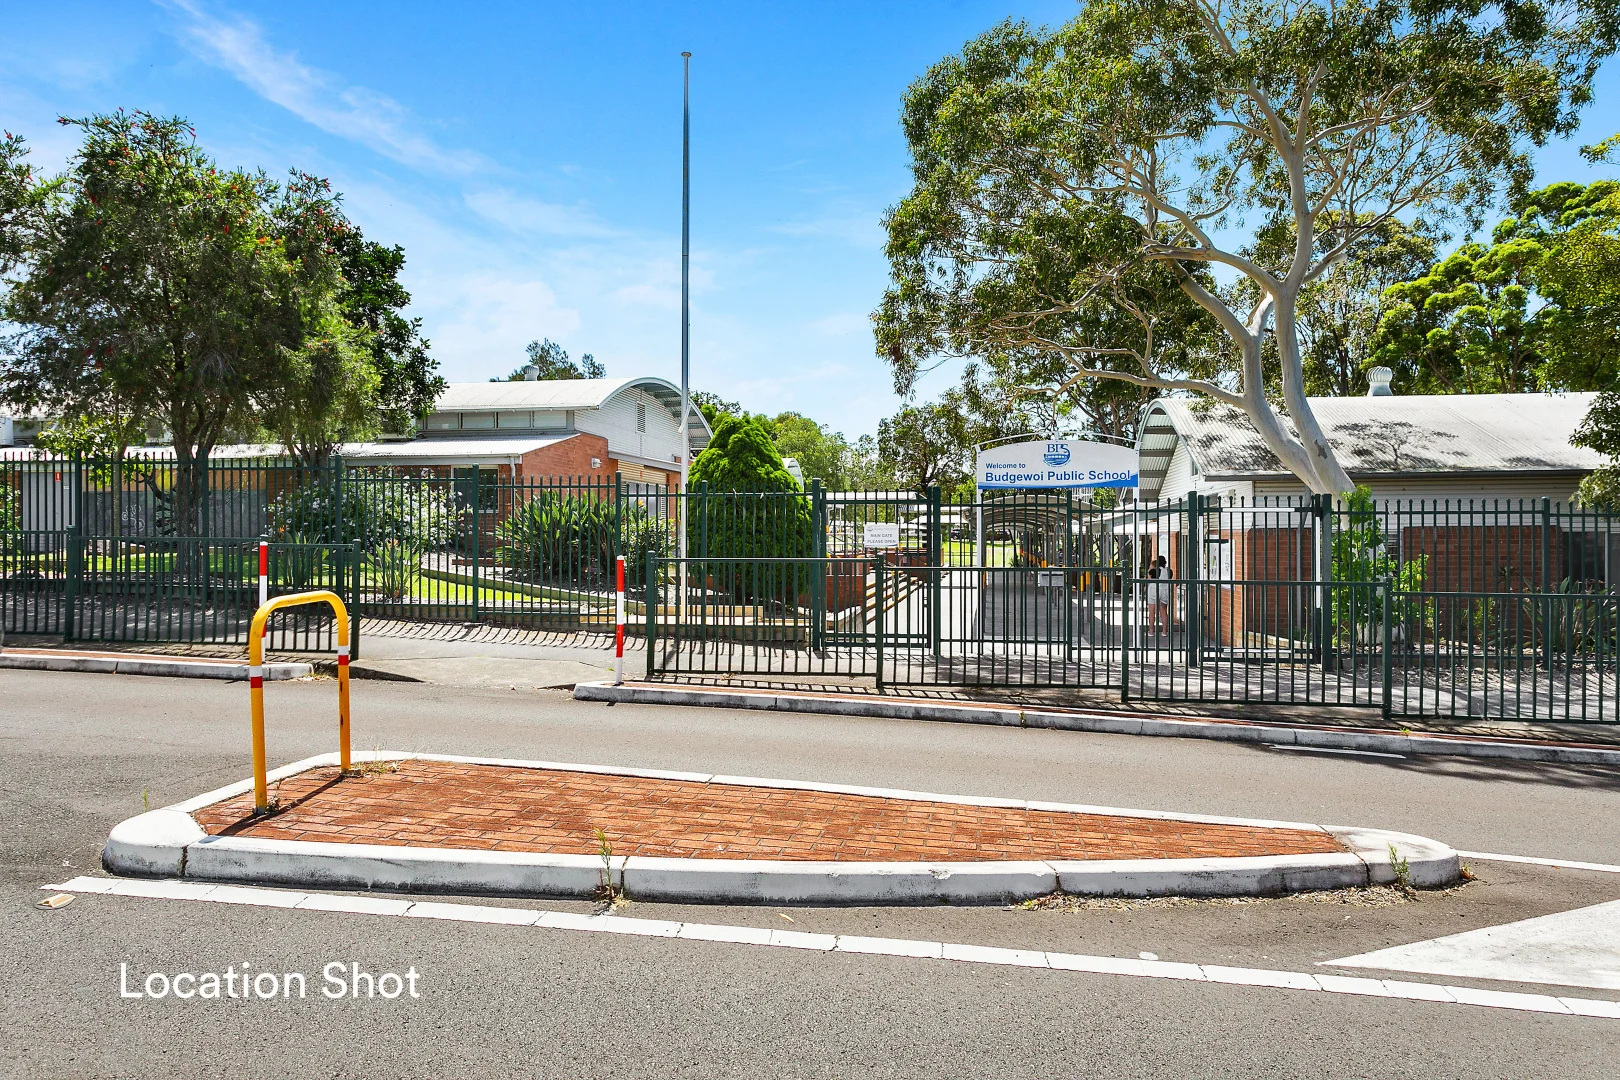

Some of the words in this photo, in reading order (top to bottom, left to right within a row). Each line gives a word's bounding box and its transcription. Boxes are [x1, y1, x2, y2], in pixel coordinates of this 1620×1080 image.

[985, 471, 1044, 483] Budgewoi
[1047, 470, 1085, 481] Public
[1088, 470, 1130, 481] School
